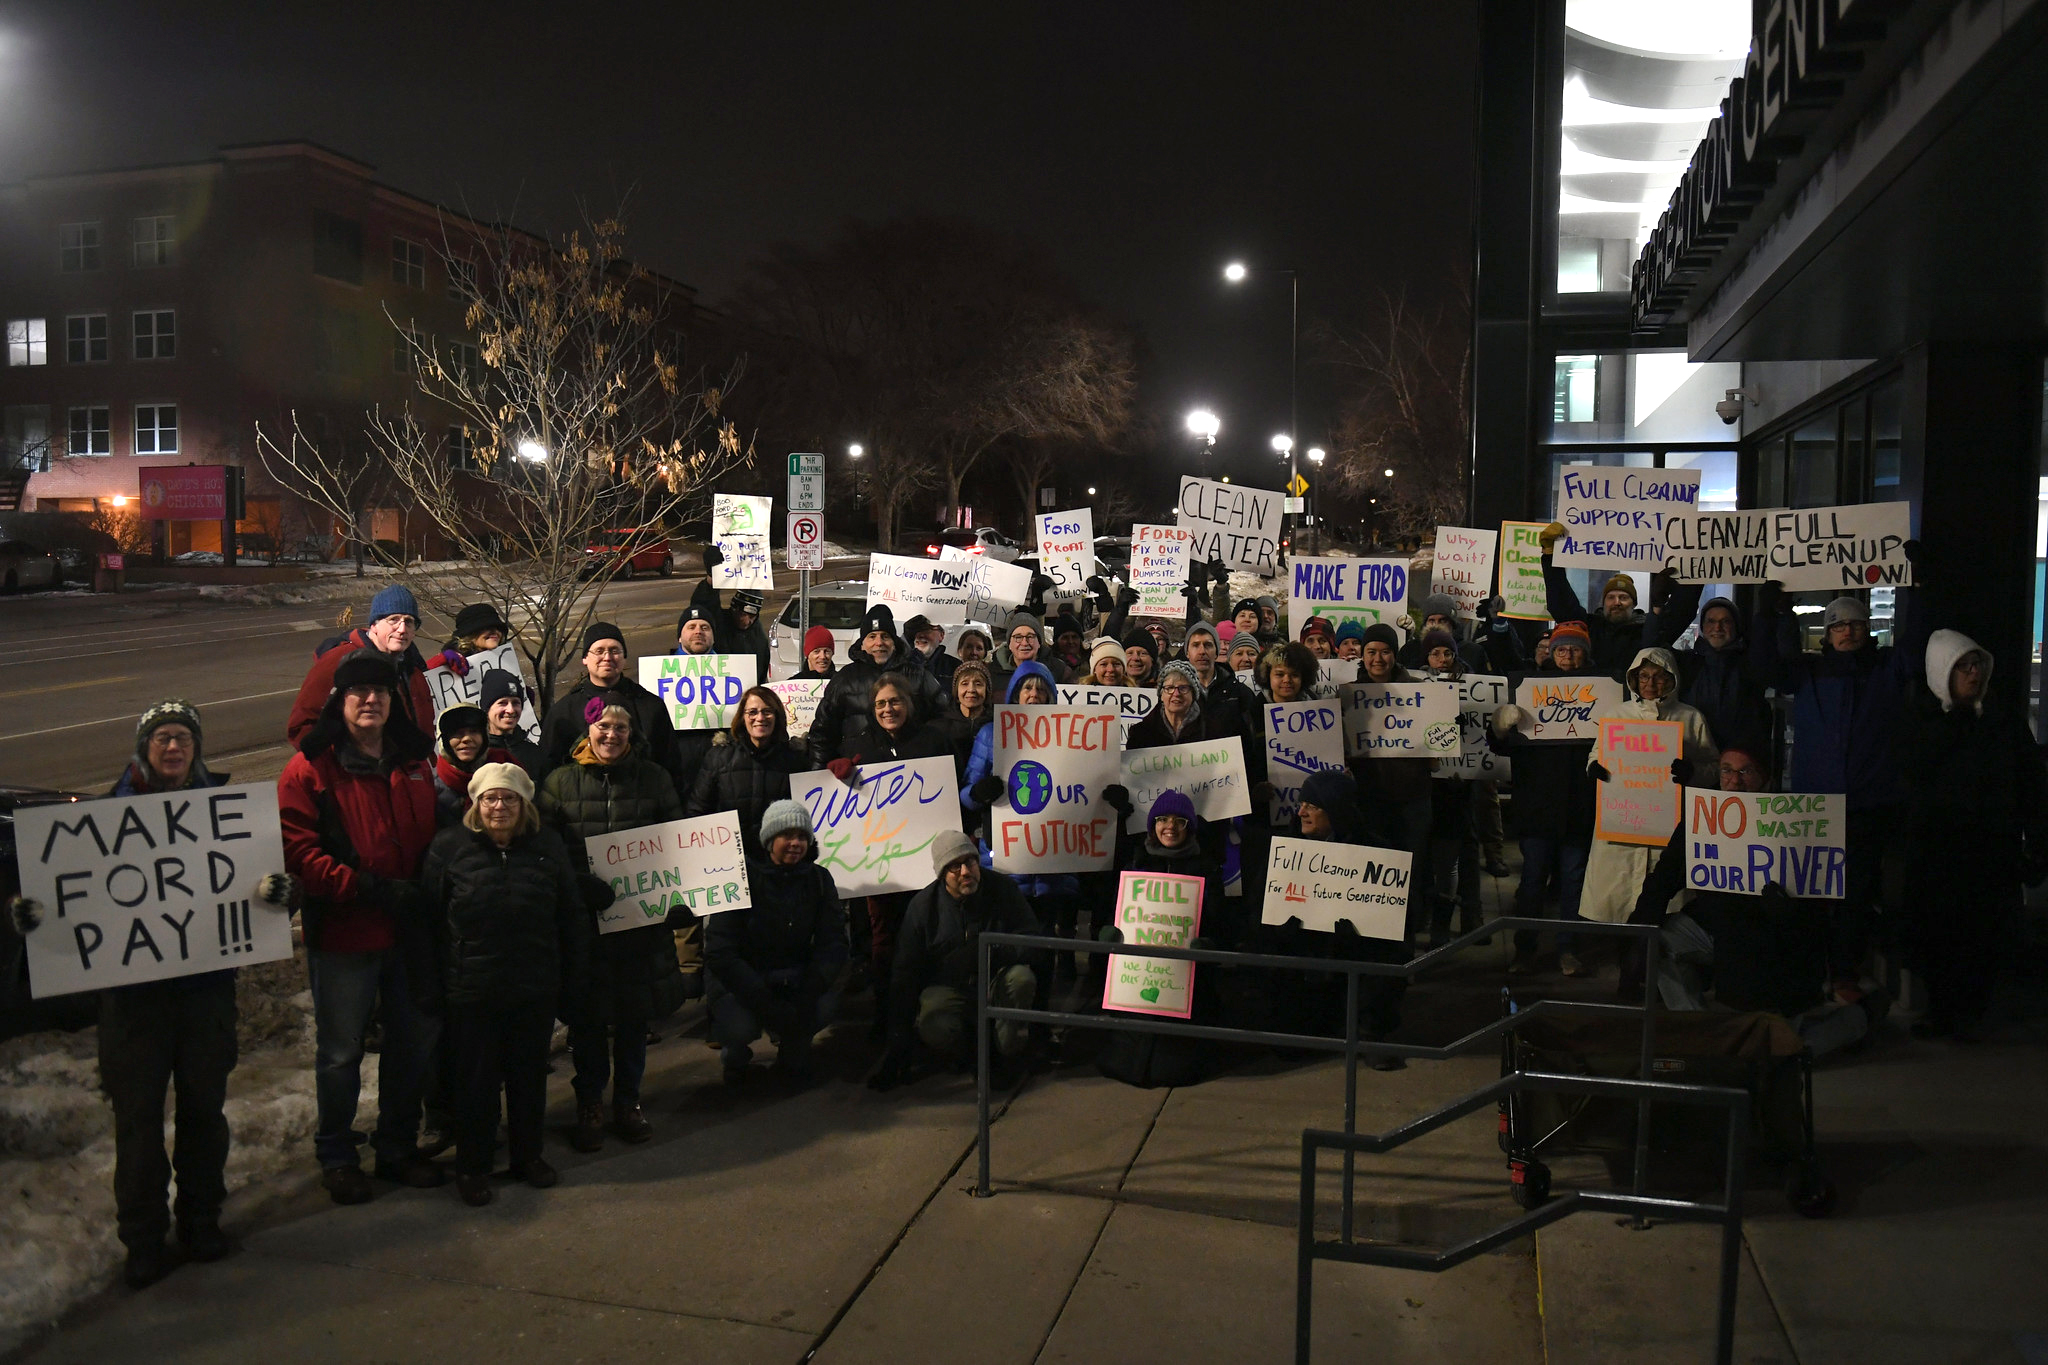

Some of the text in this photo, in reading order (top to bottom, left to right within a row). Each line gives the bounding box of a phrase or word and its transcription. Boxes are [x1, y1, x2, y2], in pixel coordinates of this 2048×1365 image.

[792, 457, 797, 473] 1
[800, 475, 813, 483] 8AM
[1563, 472, 1616, 500] FULL
[167, 495, 223, 508] CHICKEN
[799, 492, 813, 500] 6PM
[1181, 481, 1269, 531] CLEAN
[1044, 516, 1081, 535] FORD
[1565, 506, 1666, 531] SUPPORT
[1775, 512, 1856, 544] FULL
[1140, 526, 1187, 541] FORD
[1513, 528, 1543, 548] FU
[1665, 516, 1768, 551] CLEAN LA
[1131, 544, 1180, 554] FIX OUR
[1506, 549, 1541, 563] Clean
[1561, 536, 1665, 562] ALTERNATIV
[1770, 535, 1903, 568] CLEANUP
[1143, 557, 1177, 567] RIVER
[1729, 555, 1768, 579] WATE
[1841, 560, 1909, 586] NOW!
[870, 562, 970, 588] Full Cleanup NOW!
[1294, 563, 1406, 603] MAKE FORD
[1442, 567, 1475, 585] FULL
[882, 588, 898, 600] ALL
[1053, 587, 1091, 599] BILLION
[1165, 586, 1177, 594] UP
[1432, 584, 1487, 599] CLEANUP
[973, 600, 1014, 624] PAY
[1455, 600, 1476, 613] OW!
[660, 655, 730, 678] MAKE
[657, 675, 743, 706] FORD
[1354, 689, 1425, 710] Protect
[674, 704, 726, 729] PAY
[1270, 706, 1335, 735] FORD
[1384, 714, 1414, 730] Our
[1538, 696, 1597, 724] Ford
[1000, 710, 1115, 751] PROTECT
[1356, 731, 1414, 750] Future
[1427, 726, 1441, 738] Full
[1129, 749, 1229, 775] CLEAN LAND
[804, 764, 944, 833] Water
[1137, 784, 1183, 804] CLEN
[1756, 795, 1826, 815] TOXIC
[41, 792, 252, 864] MAKE
[1692, 796, 1747, 839] NO
[1756, 819, 1829, 838] WASTE
[607, 826, 731, 866] CLEAN LAND
[1001, 818, 1108, 858] FUTURE
[818, 829, 938, 884] Life
[1694, 842, 1719, 860] IN
[1274, 846, 1408, 889] Full Cleanup NOW
[1690, 844, 1846, 897] OUR RIVER
[55, 850, 236, 918] FORD
[611, 866, 682, 900] CLEAN
[1132, 879, 1189, 904] FULL
[1284, 882, 1309, 903] ALL
[1346, 887, 1406, 906] Generations
[639, 882, 741, 919] WATER
[1123, 906, 1193, 938] Cleanup
[1135, 927, 1185, 946] NOW
[1145, 960, 1175, 976] love
